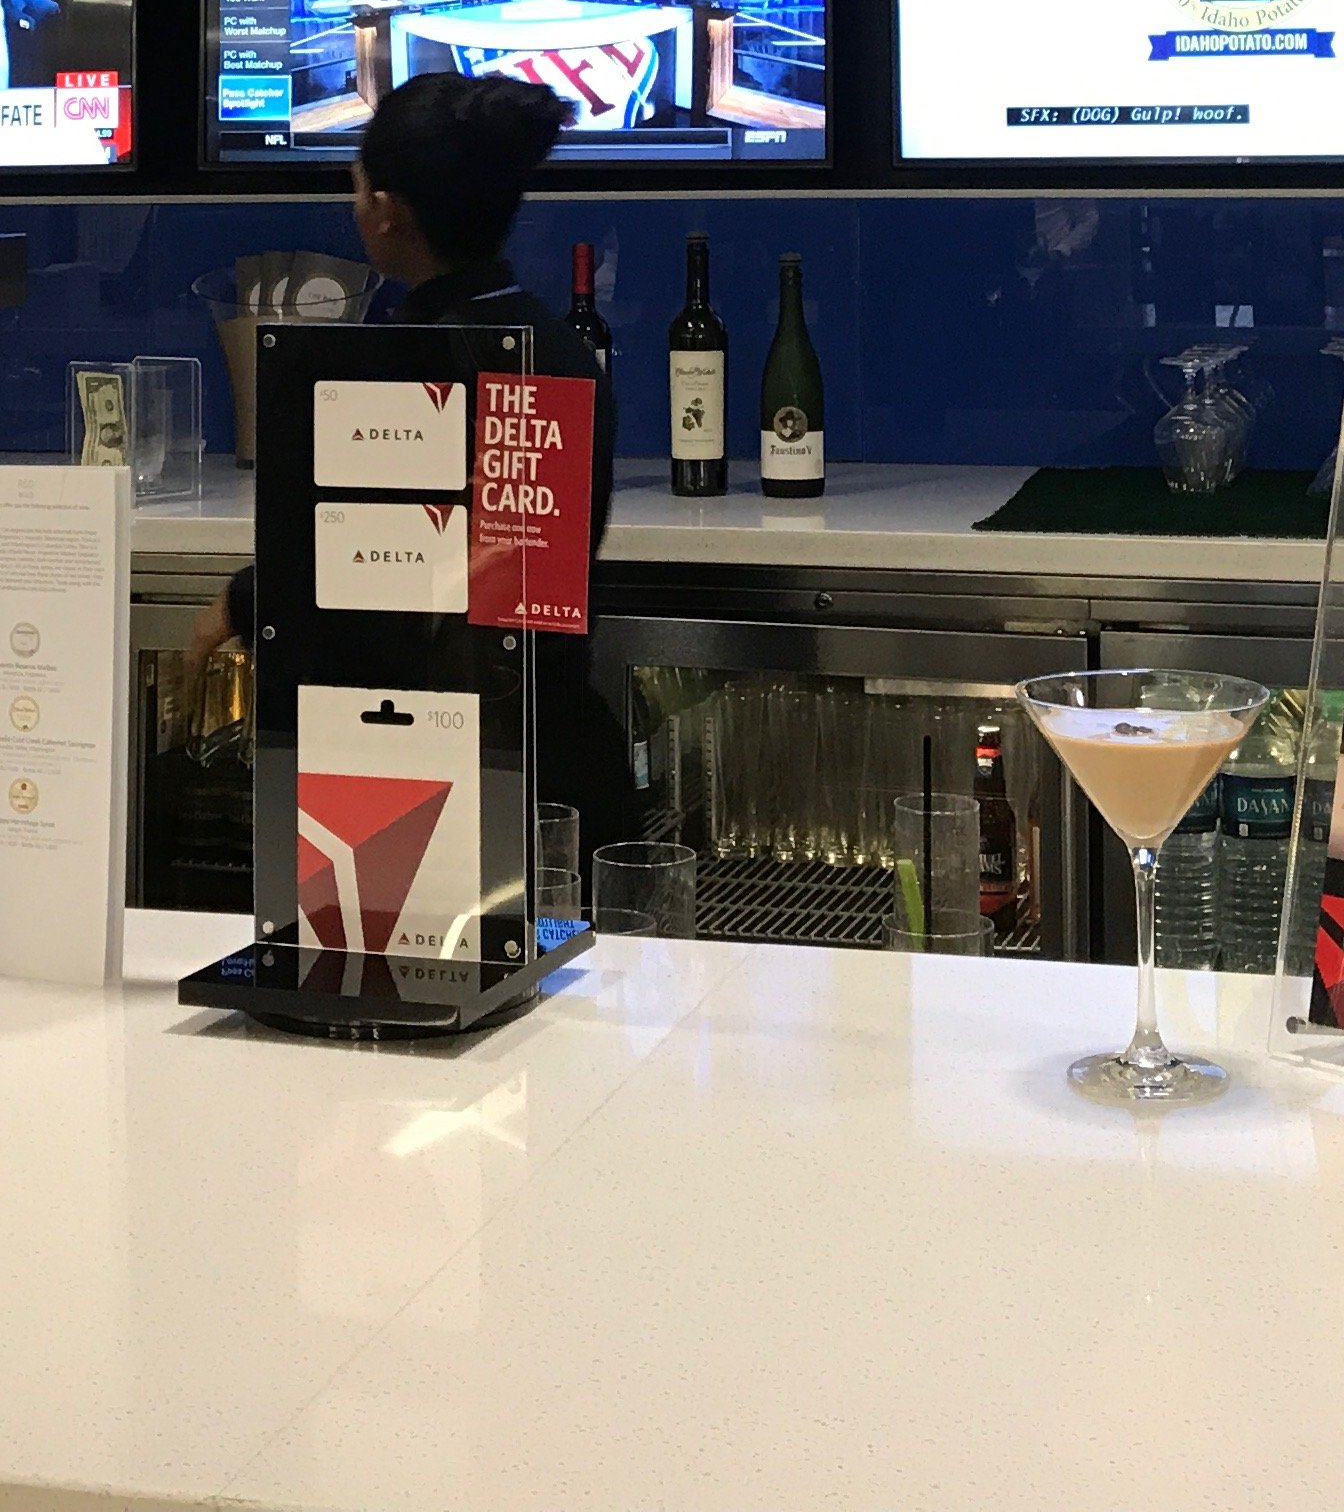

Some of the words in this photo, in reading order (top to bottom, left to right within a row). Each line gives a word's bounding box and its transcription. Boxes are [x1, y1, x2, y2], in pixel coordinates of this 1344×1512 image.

[224, 16, 237, 25] PC
[1201, 6, 1250, 28] Idaho
[1175, 33, 1308, 52] IDAHOPOTATO.COM
[224, 50, 237, 59] PC
[245, 60, 283, 70] Matchup
[64, 74, 110, 87] LIVE
[1, 104, 44, 127] FATE
[63, 96, 110, 120] CNN
[1020, 108, 1060, 122] SFX:
[1072, 106, 1120, 124] (DOG)
[1130, 106, 1181, 124] Gulp!
[264, 134, 287, 145] NFL
[744, 130, 787, 144] ESPN
[485, 382, 538, 415] THE
[369, 428, 424, 442] DELTA
[484, 415, 564, 450] DELTA
[770, 444, 805, 456] Faustino
[483, 448, 543, 481] GIFT
[481, 481, 561, 517] CARD.
[369, 550, 425, 564] DELTA
[531, 603, 582, 619] DELTA
[427, 710, 465, 730] $100
